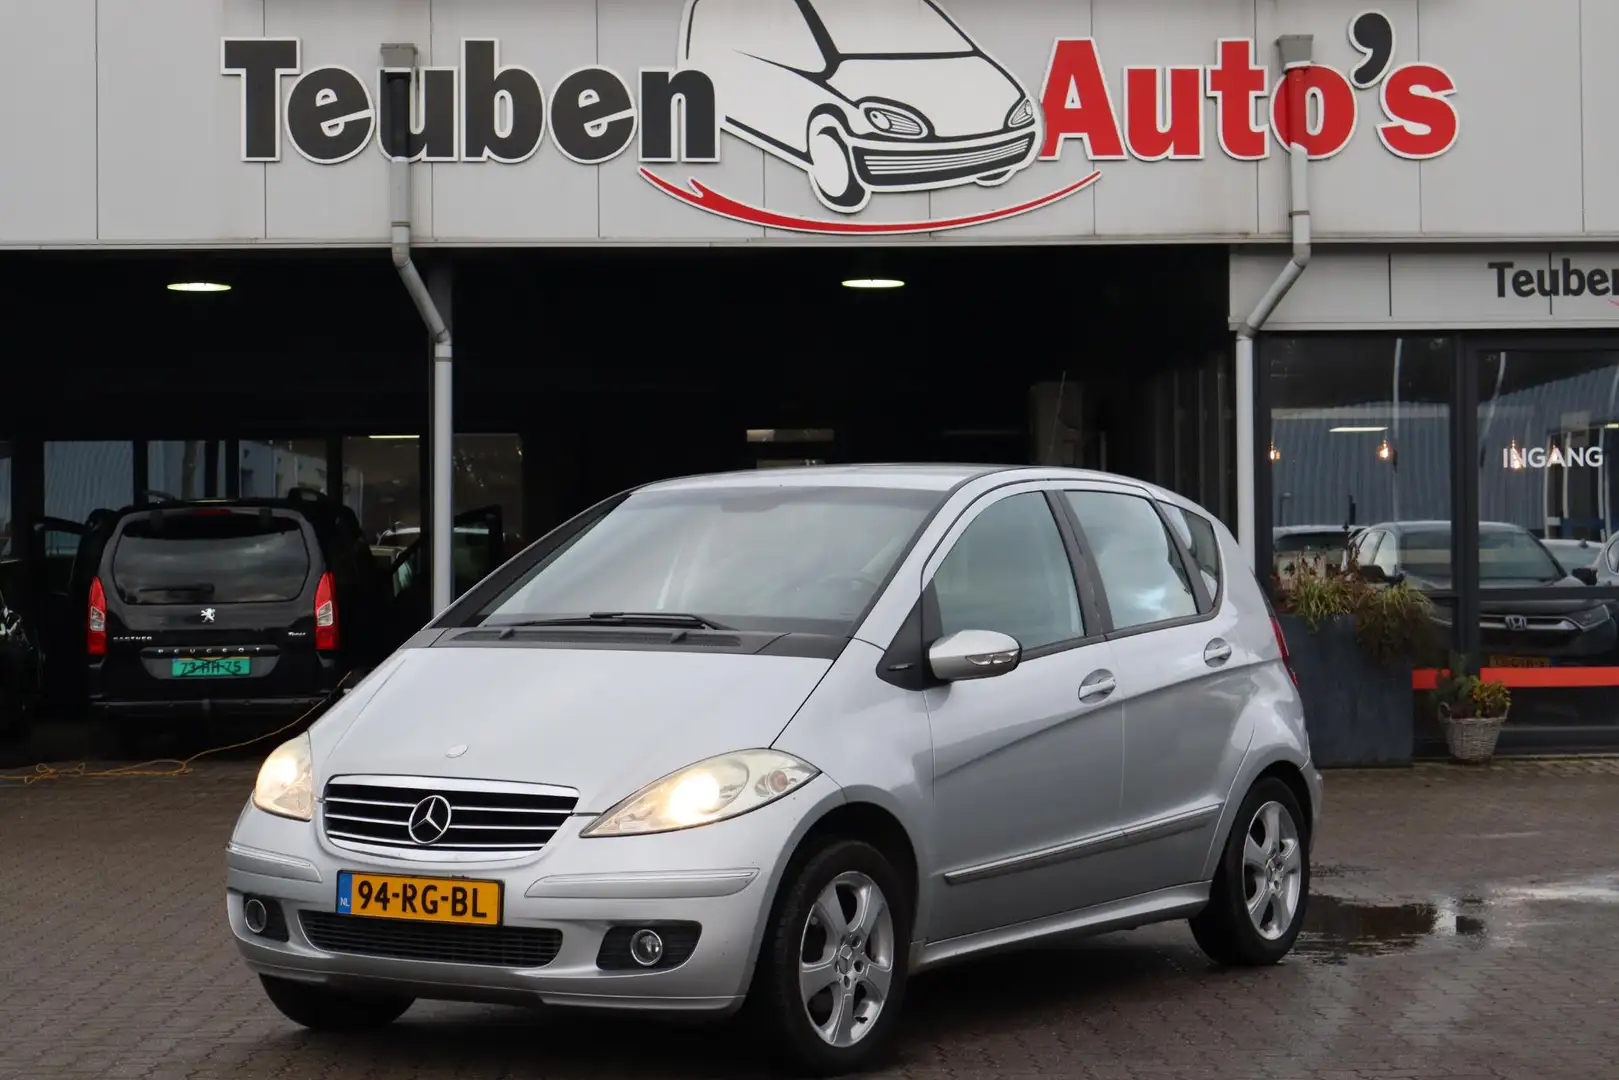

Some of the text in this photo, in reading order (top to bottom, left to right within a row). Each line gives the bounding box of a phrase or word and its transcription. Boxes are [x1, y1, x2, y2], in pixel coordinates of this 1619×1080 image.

[221, 11, 1459, 163] Teuben Auto's
[1502, 446, 1604, 469] INGANG
[339, 880, 487, 918] NL 94-RG-BL
